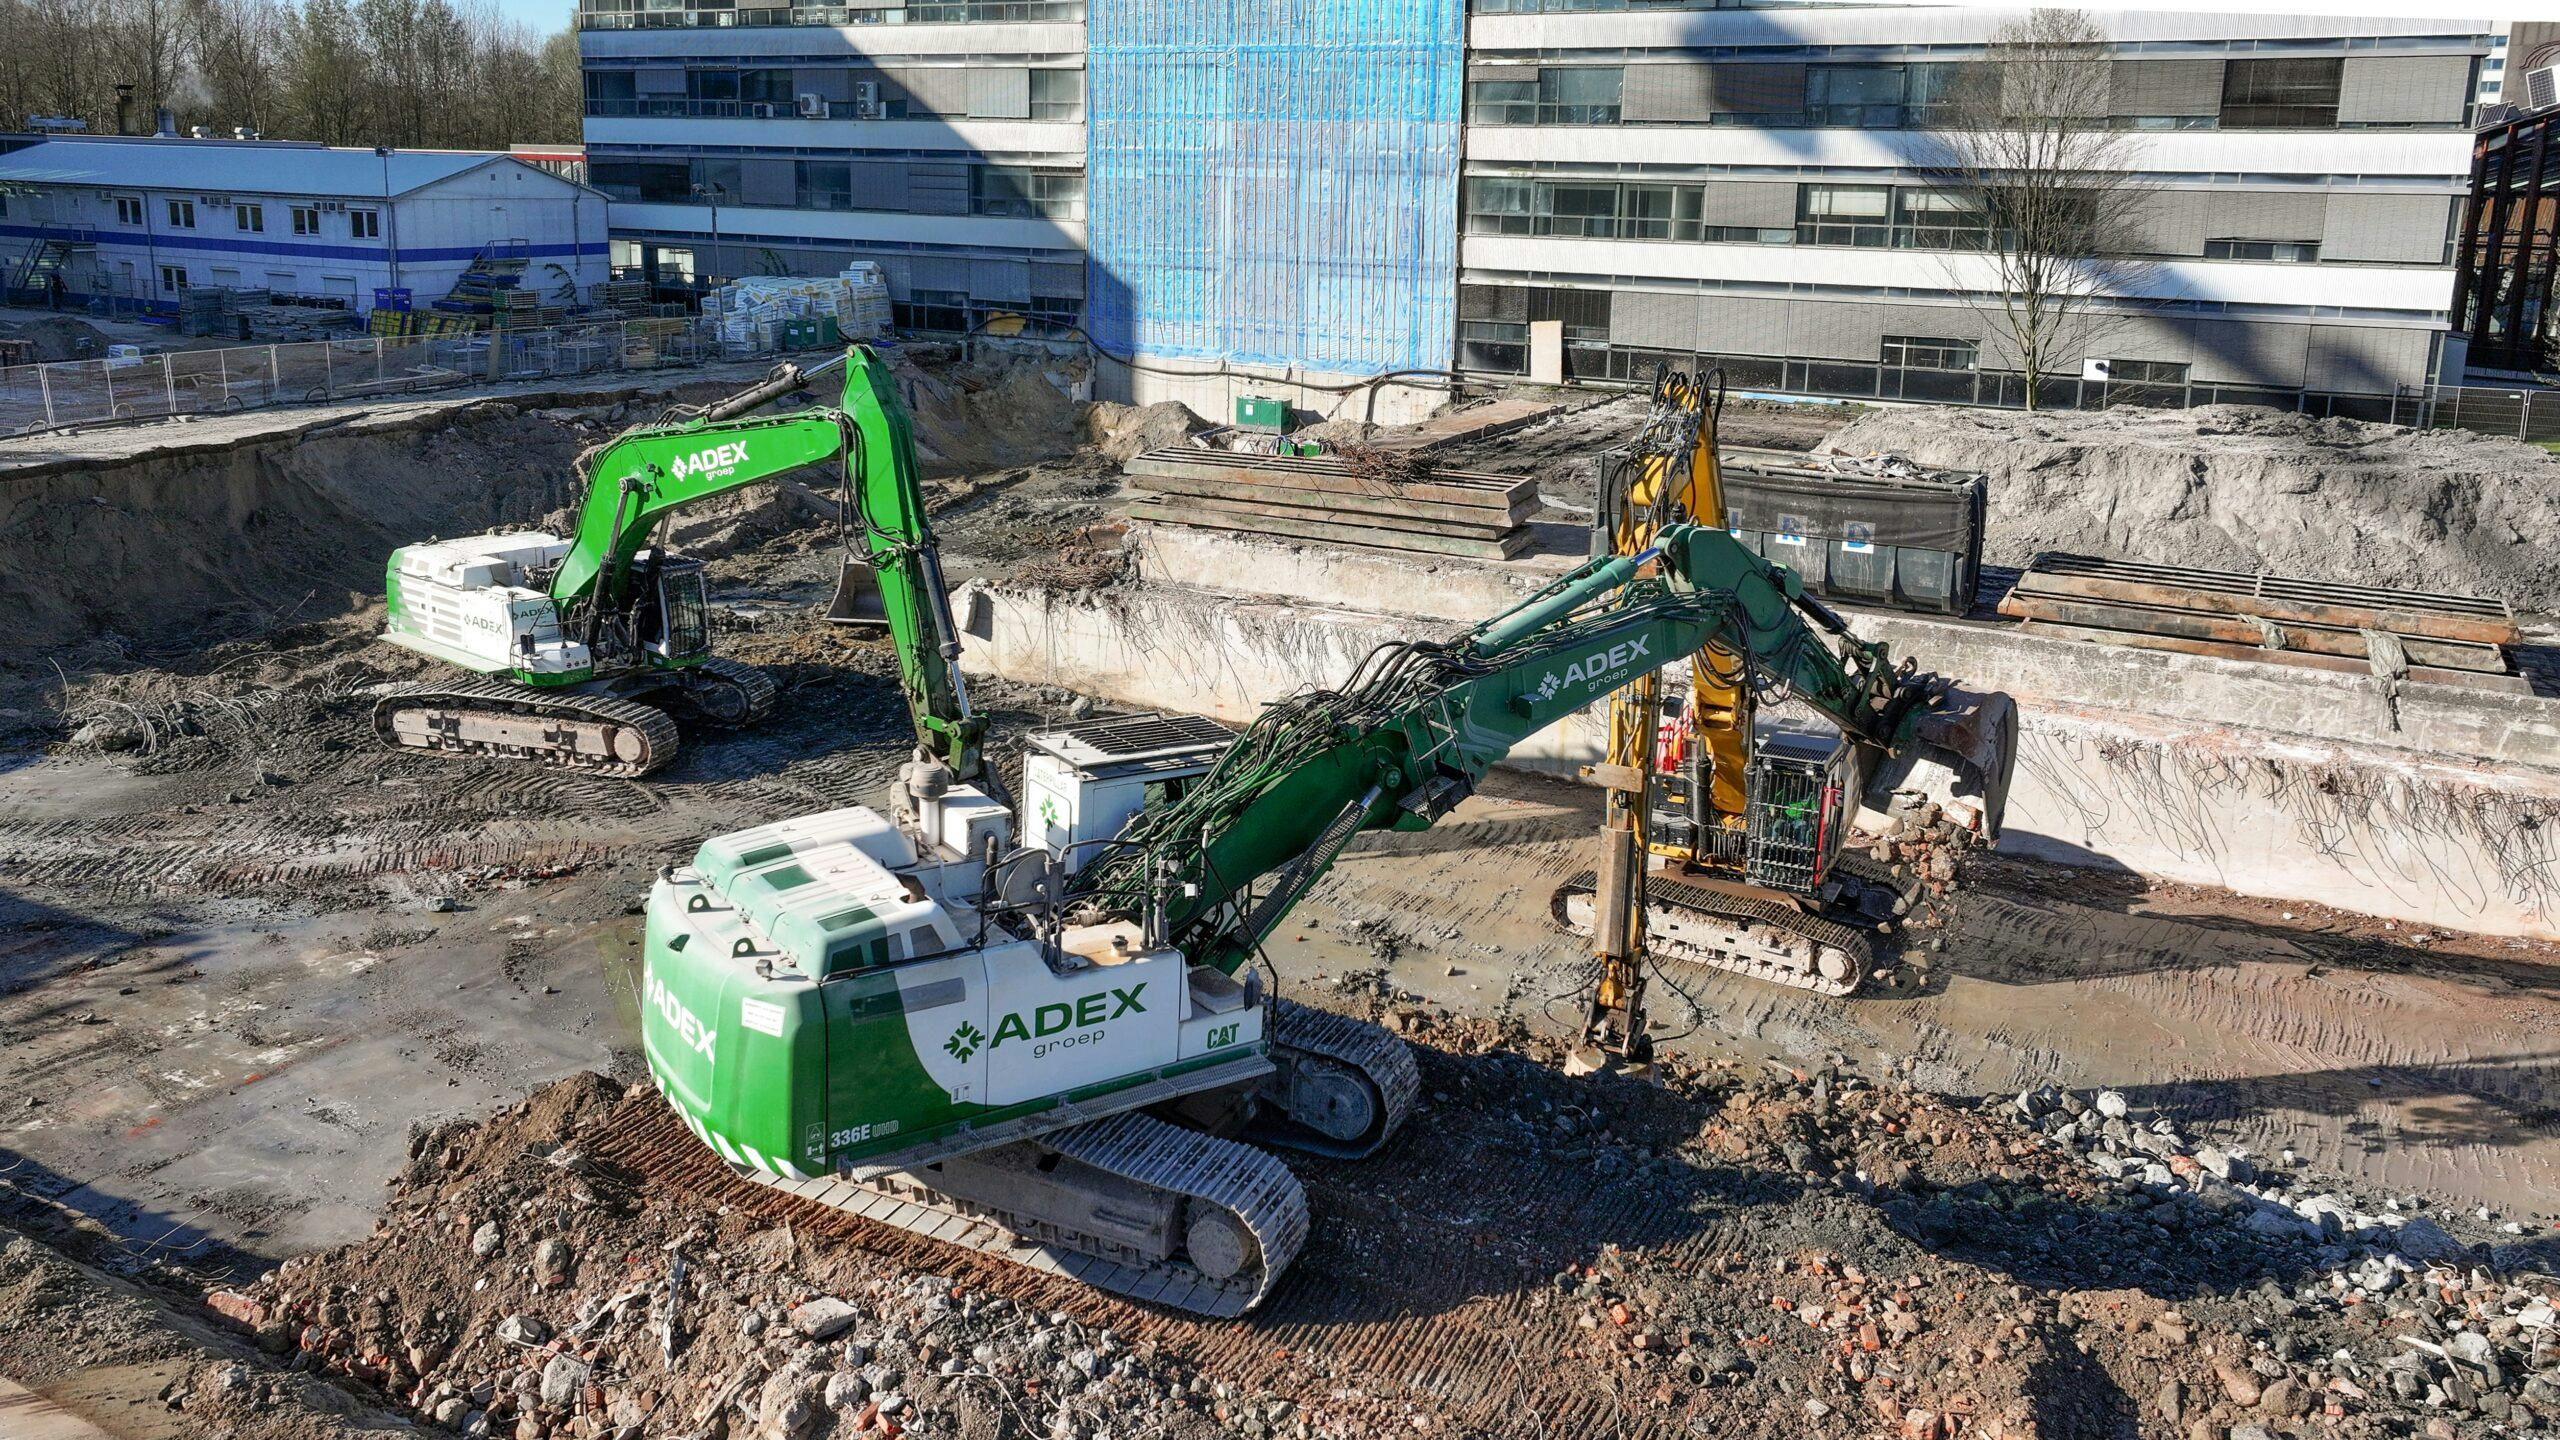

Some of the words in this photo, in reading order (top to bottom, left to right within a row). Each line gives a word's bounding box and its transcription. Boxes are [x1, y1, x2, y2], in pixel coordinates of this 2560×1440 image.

[688, 440, 750, 475] ADEX
[705, 466, 735, 481] groep
[472, 616, 503, 635] ADEX
[1562, 633, 1651, 689] ADEX
[1587, 668, 1628, 692] groep
[653, 978, 717, 1066] ADEX
[989, 981, 1148, 1049] ADEX
[1033, 1029, 1105, 1058] groep
[1206, 1022, 1240, 1050] CAT
[831, 1123, 871, 1148] 336E
[872, 1119, 899, 1138] UHD
